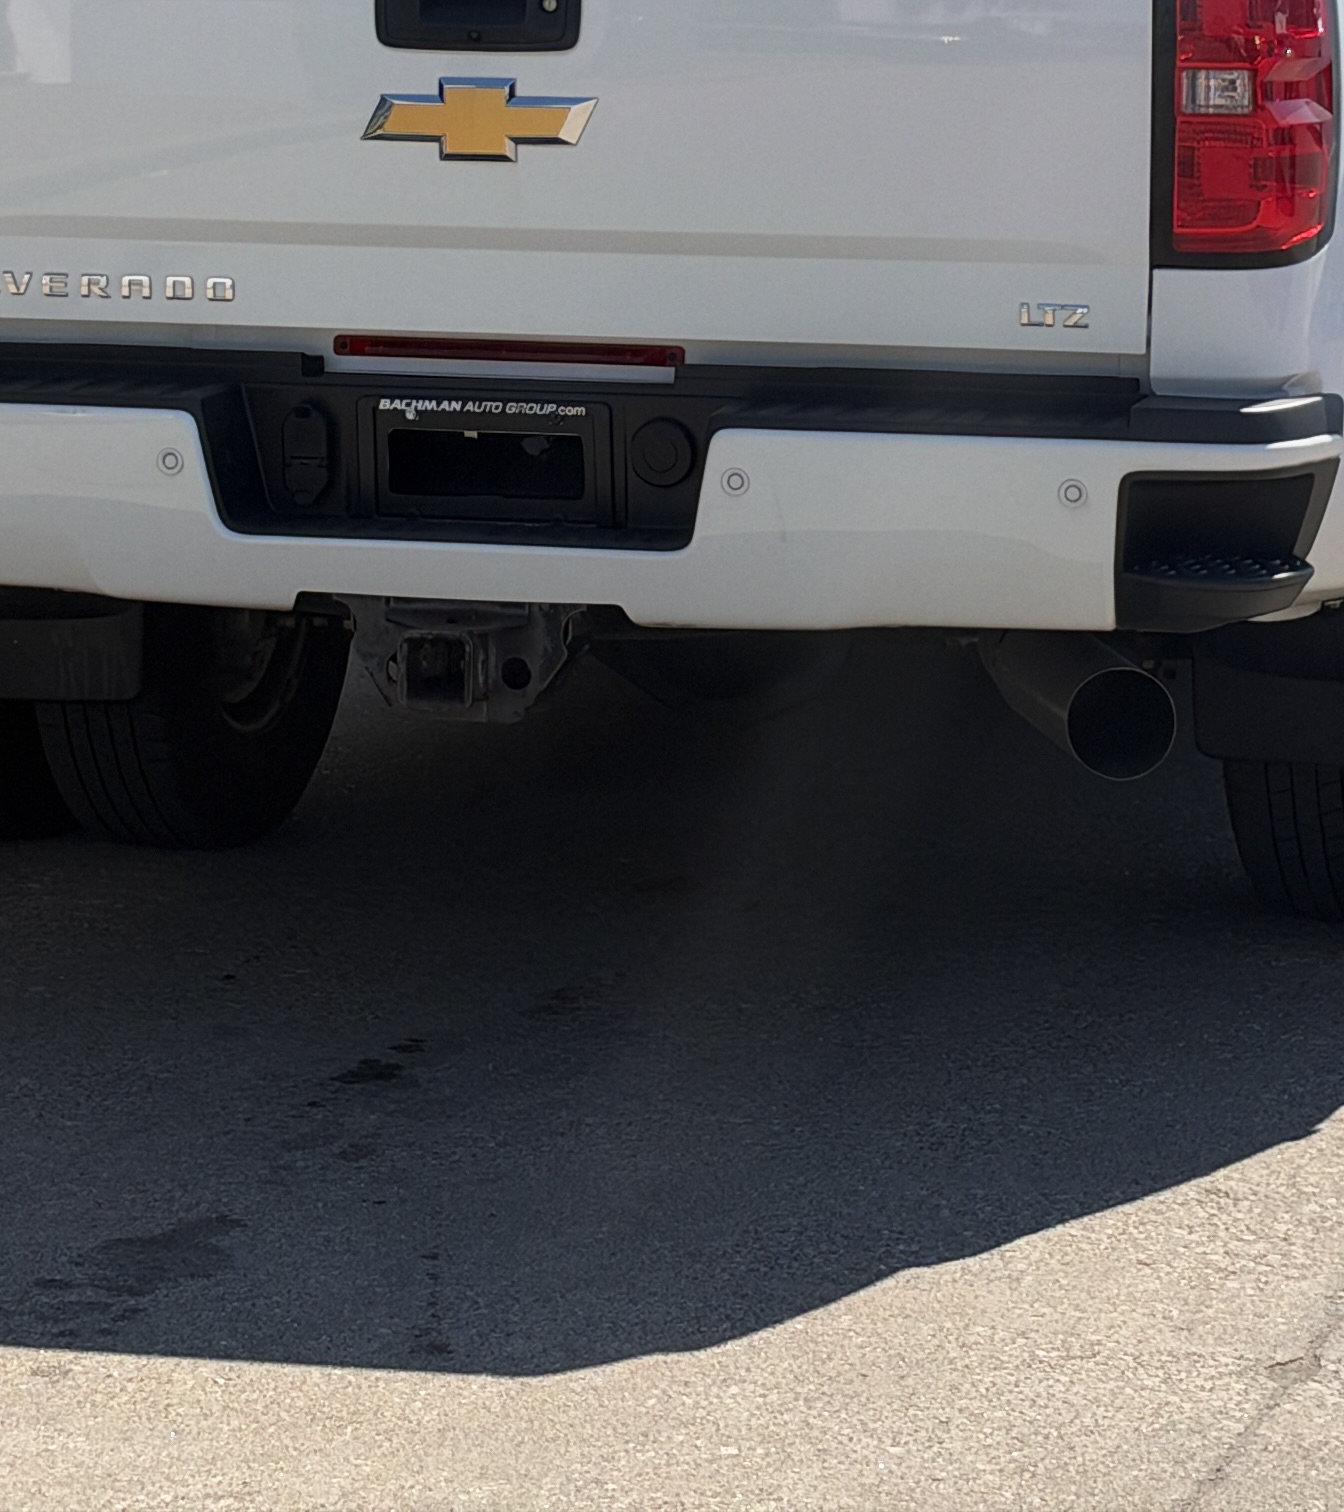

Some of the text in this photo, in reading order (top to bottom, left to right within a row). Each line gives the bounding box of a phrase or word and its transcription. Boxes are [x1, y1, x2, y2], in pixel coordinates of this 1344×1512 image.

[1020, 302, 1090, 329] LTZ
[378, 398, 586, 416] BACHMAN AUTO GROUP.com
